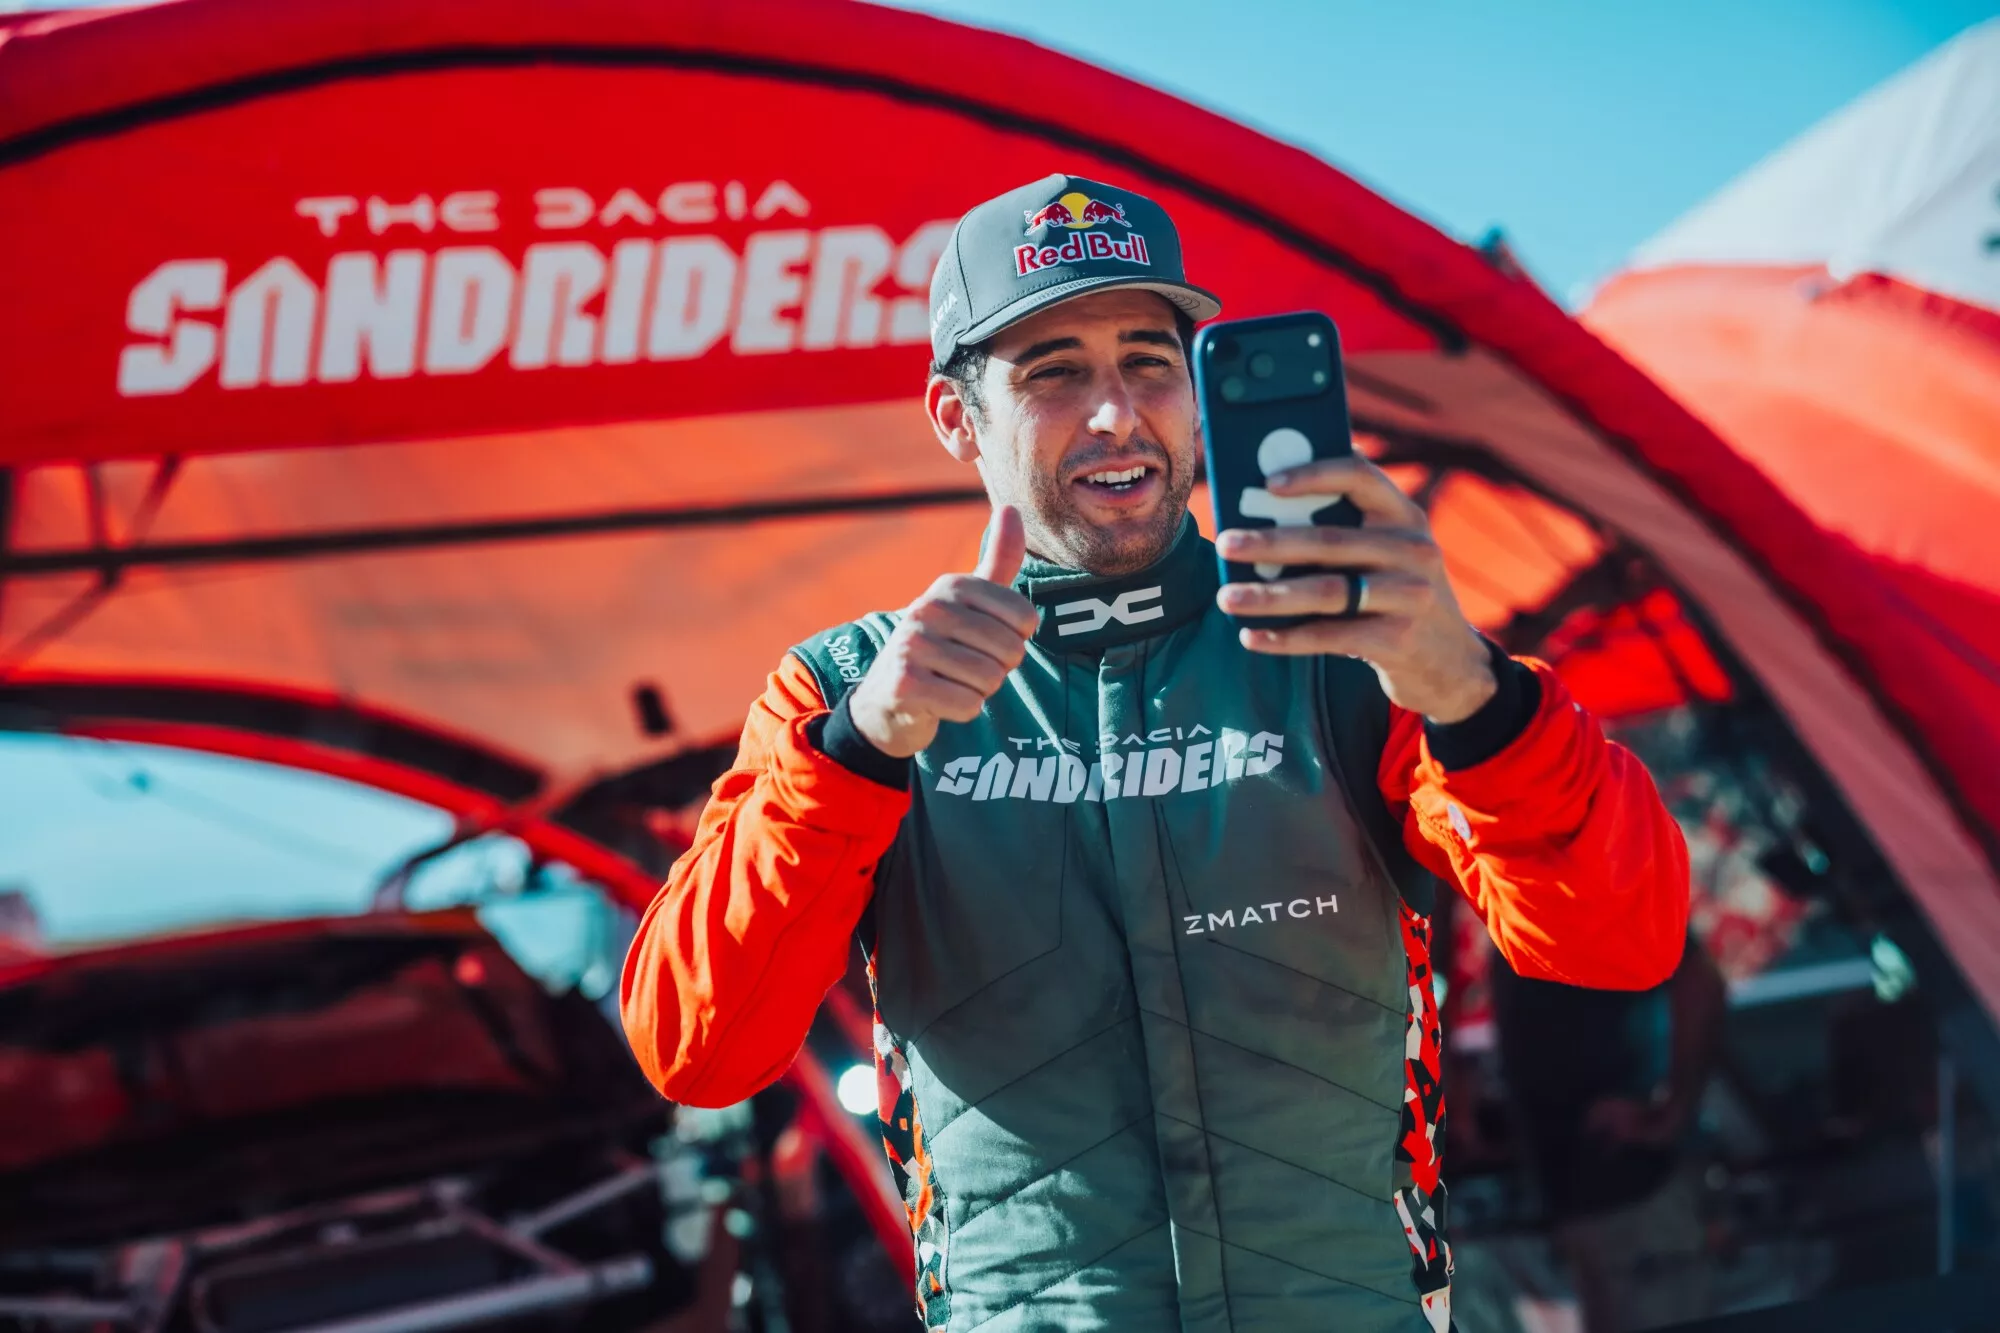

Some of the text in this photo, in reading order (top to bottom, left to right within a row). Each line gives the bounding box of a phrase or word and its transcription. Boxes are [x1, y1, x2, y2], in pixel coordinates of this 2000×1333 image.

[294, 179, 811, 237] THE DACIA
[1013, 231, 1151, 277] Red Bull
[930, 292, 958, 342] ACIA
[823, 634, 865, 683] Sabel
[1008, 723, 1213, 755] THE DACIA
[935, 730, 1284, 804] SANDRIDERS
[1183, 894, 1338, 934] ZMATCH
